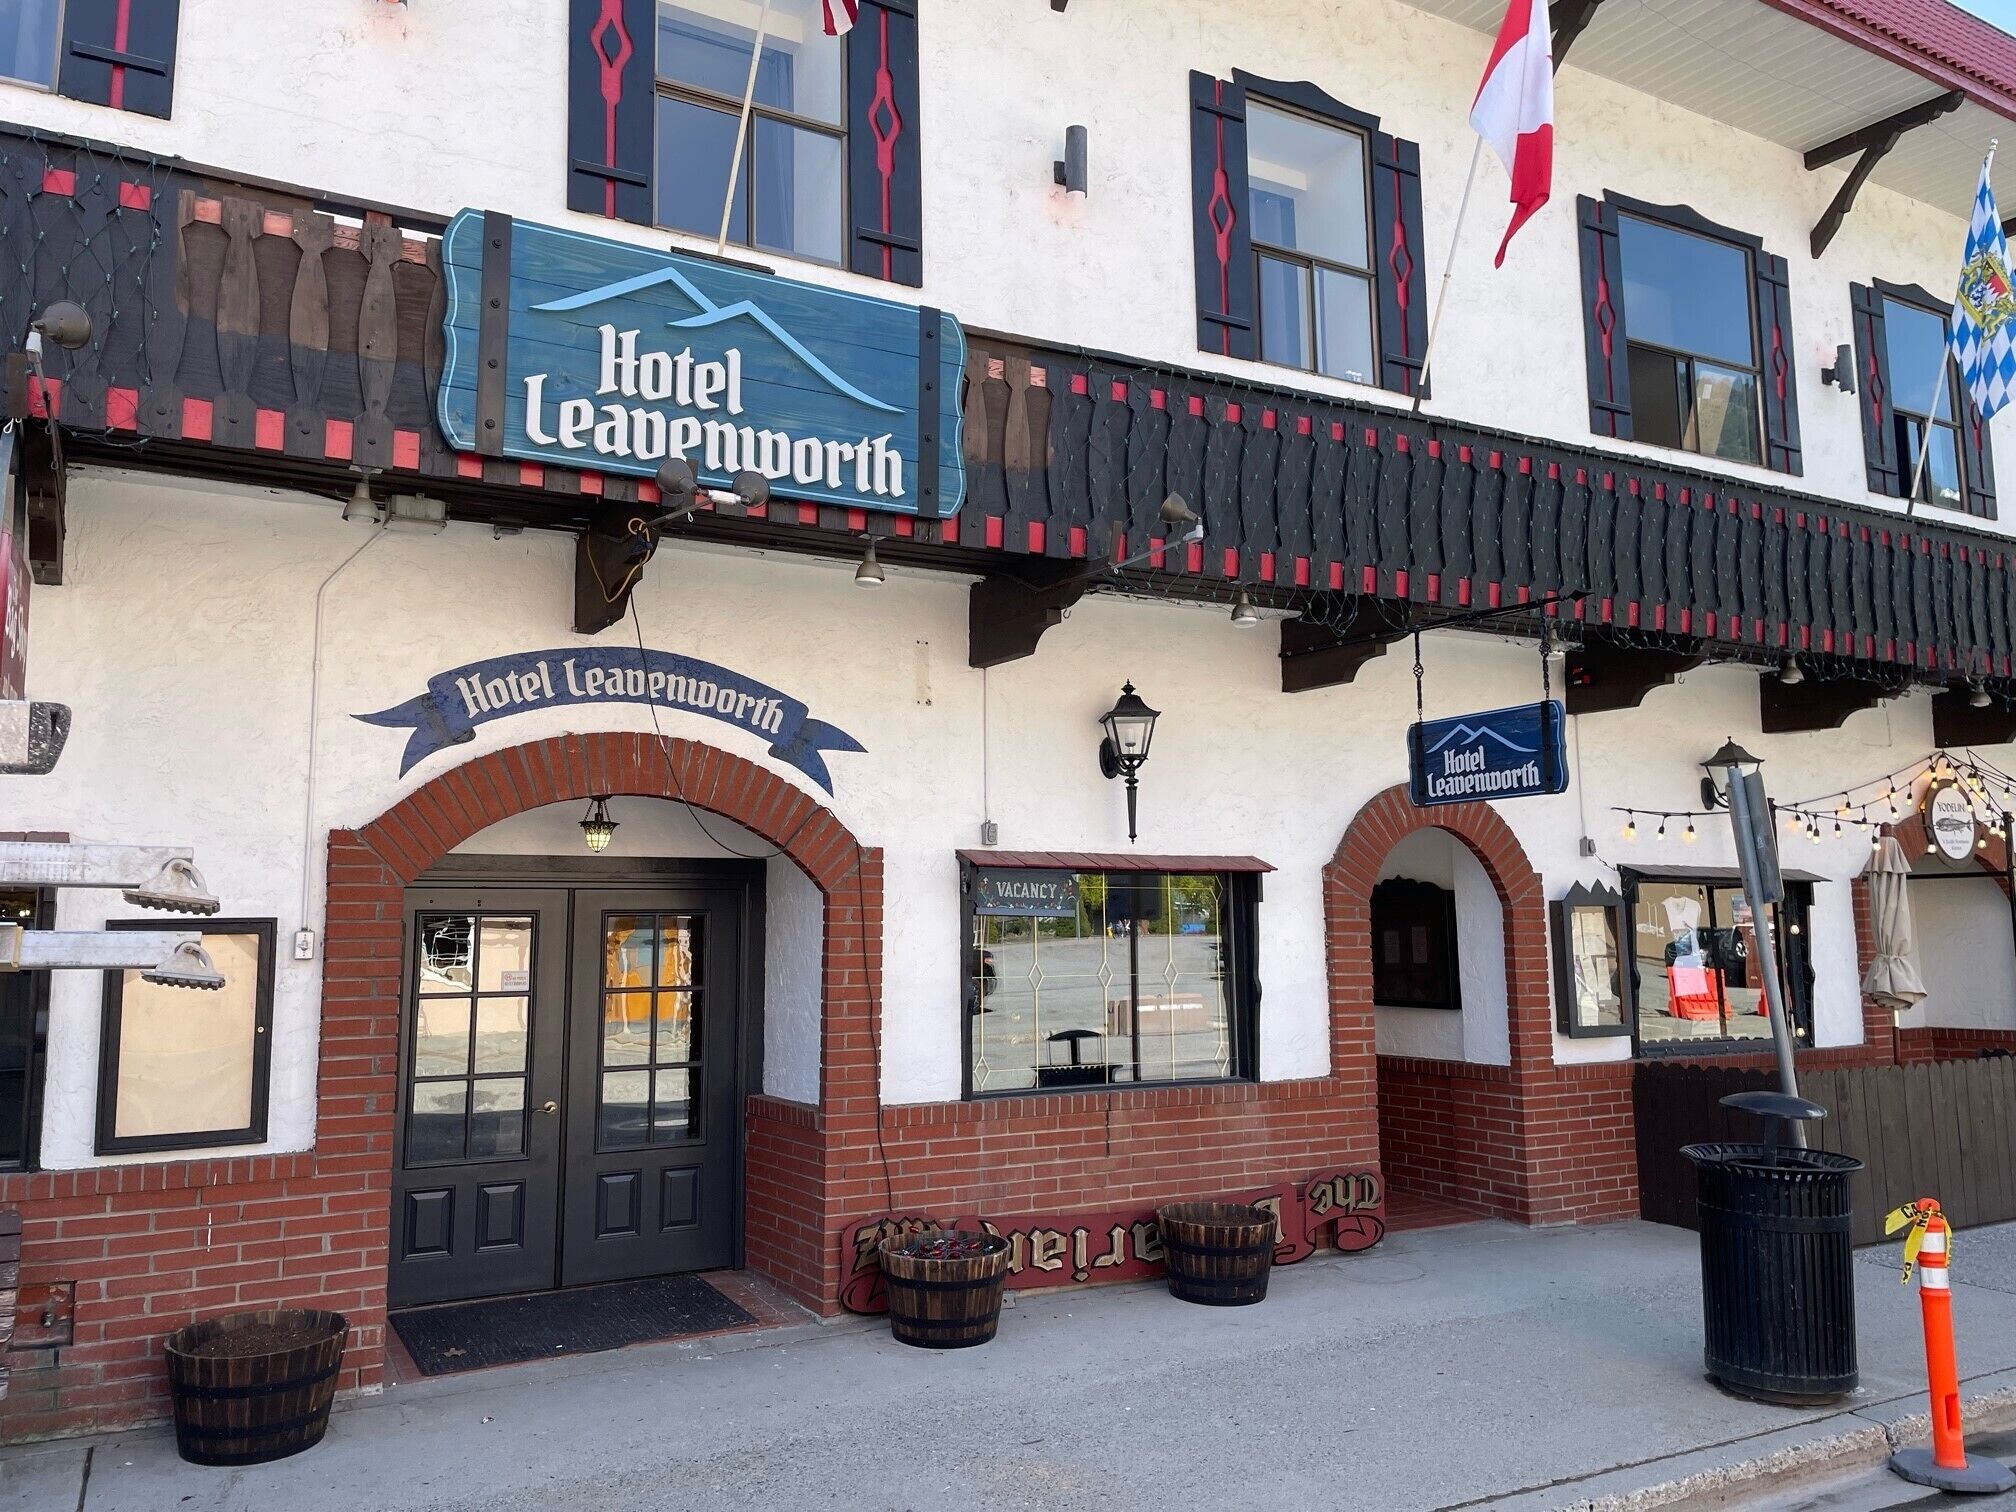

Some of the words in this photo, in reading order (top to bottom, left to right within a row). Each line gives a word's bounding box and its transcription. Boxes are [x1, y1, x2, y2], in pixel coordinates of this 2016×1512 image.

[595, 323, 744, 415] Hotel
[523, 373, 905, 498] Leavenworth
[455, 660, 555, 719] Hotel
[562, 658, 785, 734] Leavenworth
[1427, 760, 1541, 798] Leavenworth
[1443, 745, 1486, 776] Hotel
[996, 881, 1057, 899] VACANCY
[1309, 1172, 1380, 1216] The
